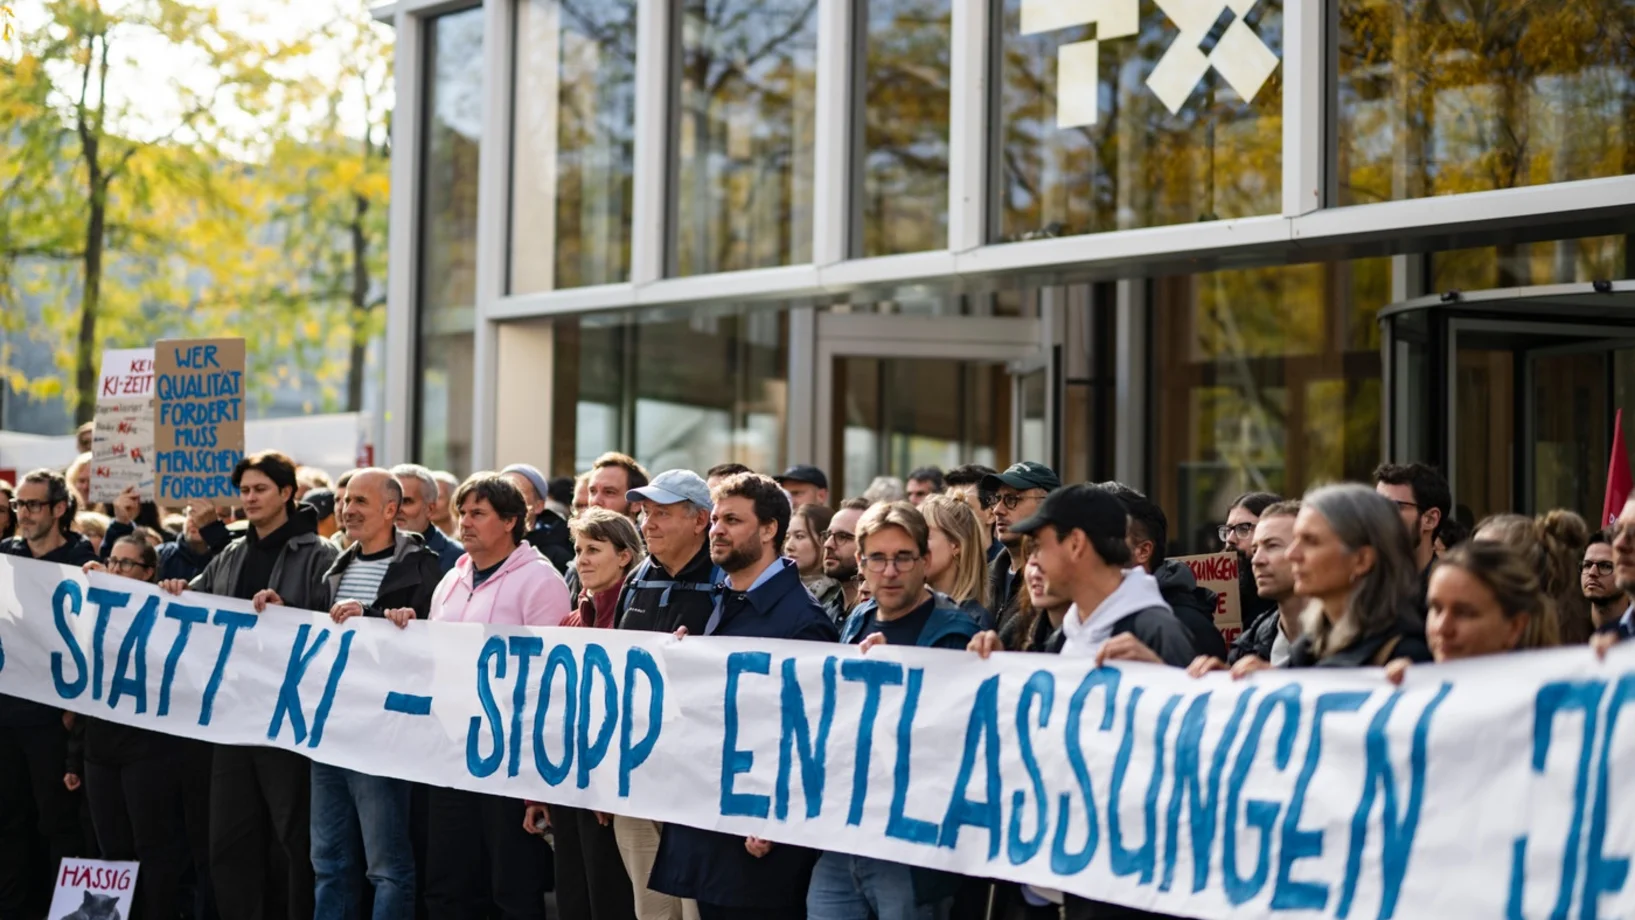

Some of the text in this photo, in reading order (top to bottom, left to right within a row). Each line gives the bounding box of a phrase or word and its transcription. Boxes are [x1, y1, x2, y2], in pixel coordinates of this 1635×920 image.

[175, 345, 220, 369] WER
[157, 369, 241, 400] QUALITÄT
[160, 399, 241, 426] FORDERT
[174, 426, 218, 448] MUSS
[156, 450, 244, 473] MENSCHEN
[51, 579, 258, 726] STATT
[266, 623, 355, 748] KI
[466, 635, 664, 797] STOPP
[720, 651, 1453, 920] ENTLASSUNGEN
[61, 865, 131, 890] HÄSSIG
